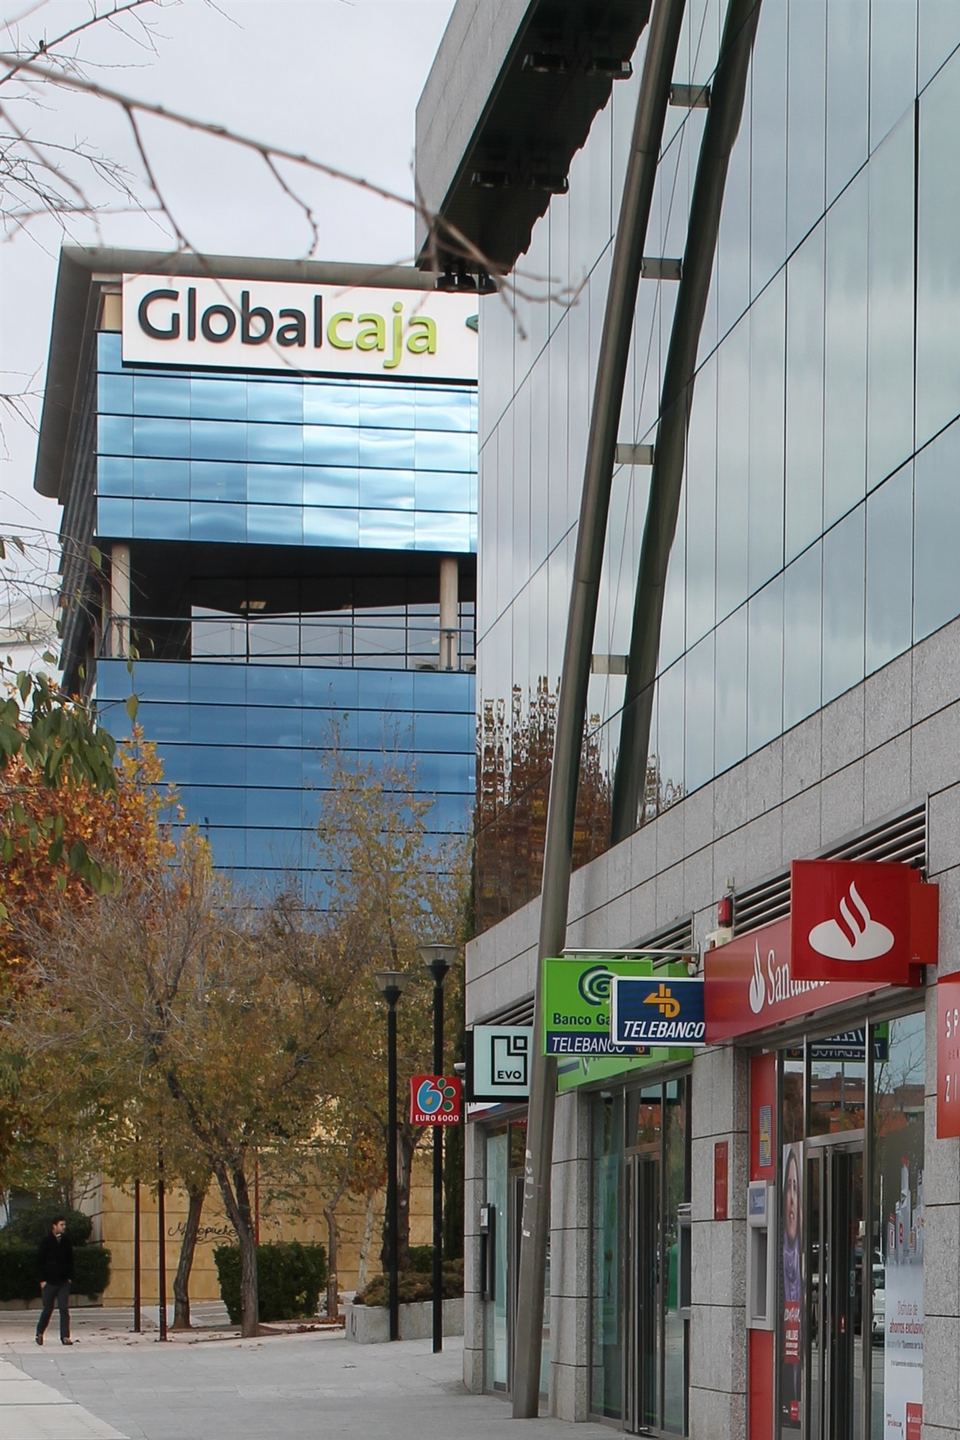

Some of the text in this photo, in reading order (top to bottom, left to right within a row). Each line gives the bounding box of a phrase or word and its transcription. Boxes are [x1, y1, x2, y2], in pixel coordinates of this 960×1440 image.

[137, 287, 438, 369] Globalcaja
[552, 1012, 592, 1026] Banco
[623, 1020, 706, 1039] TELEBANCO
[497, 1070, 522, 1080] EVO
[415, 1114, 459, 1122] EURO 6000
